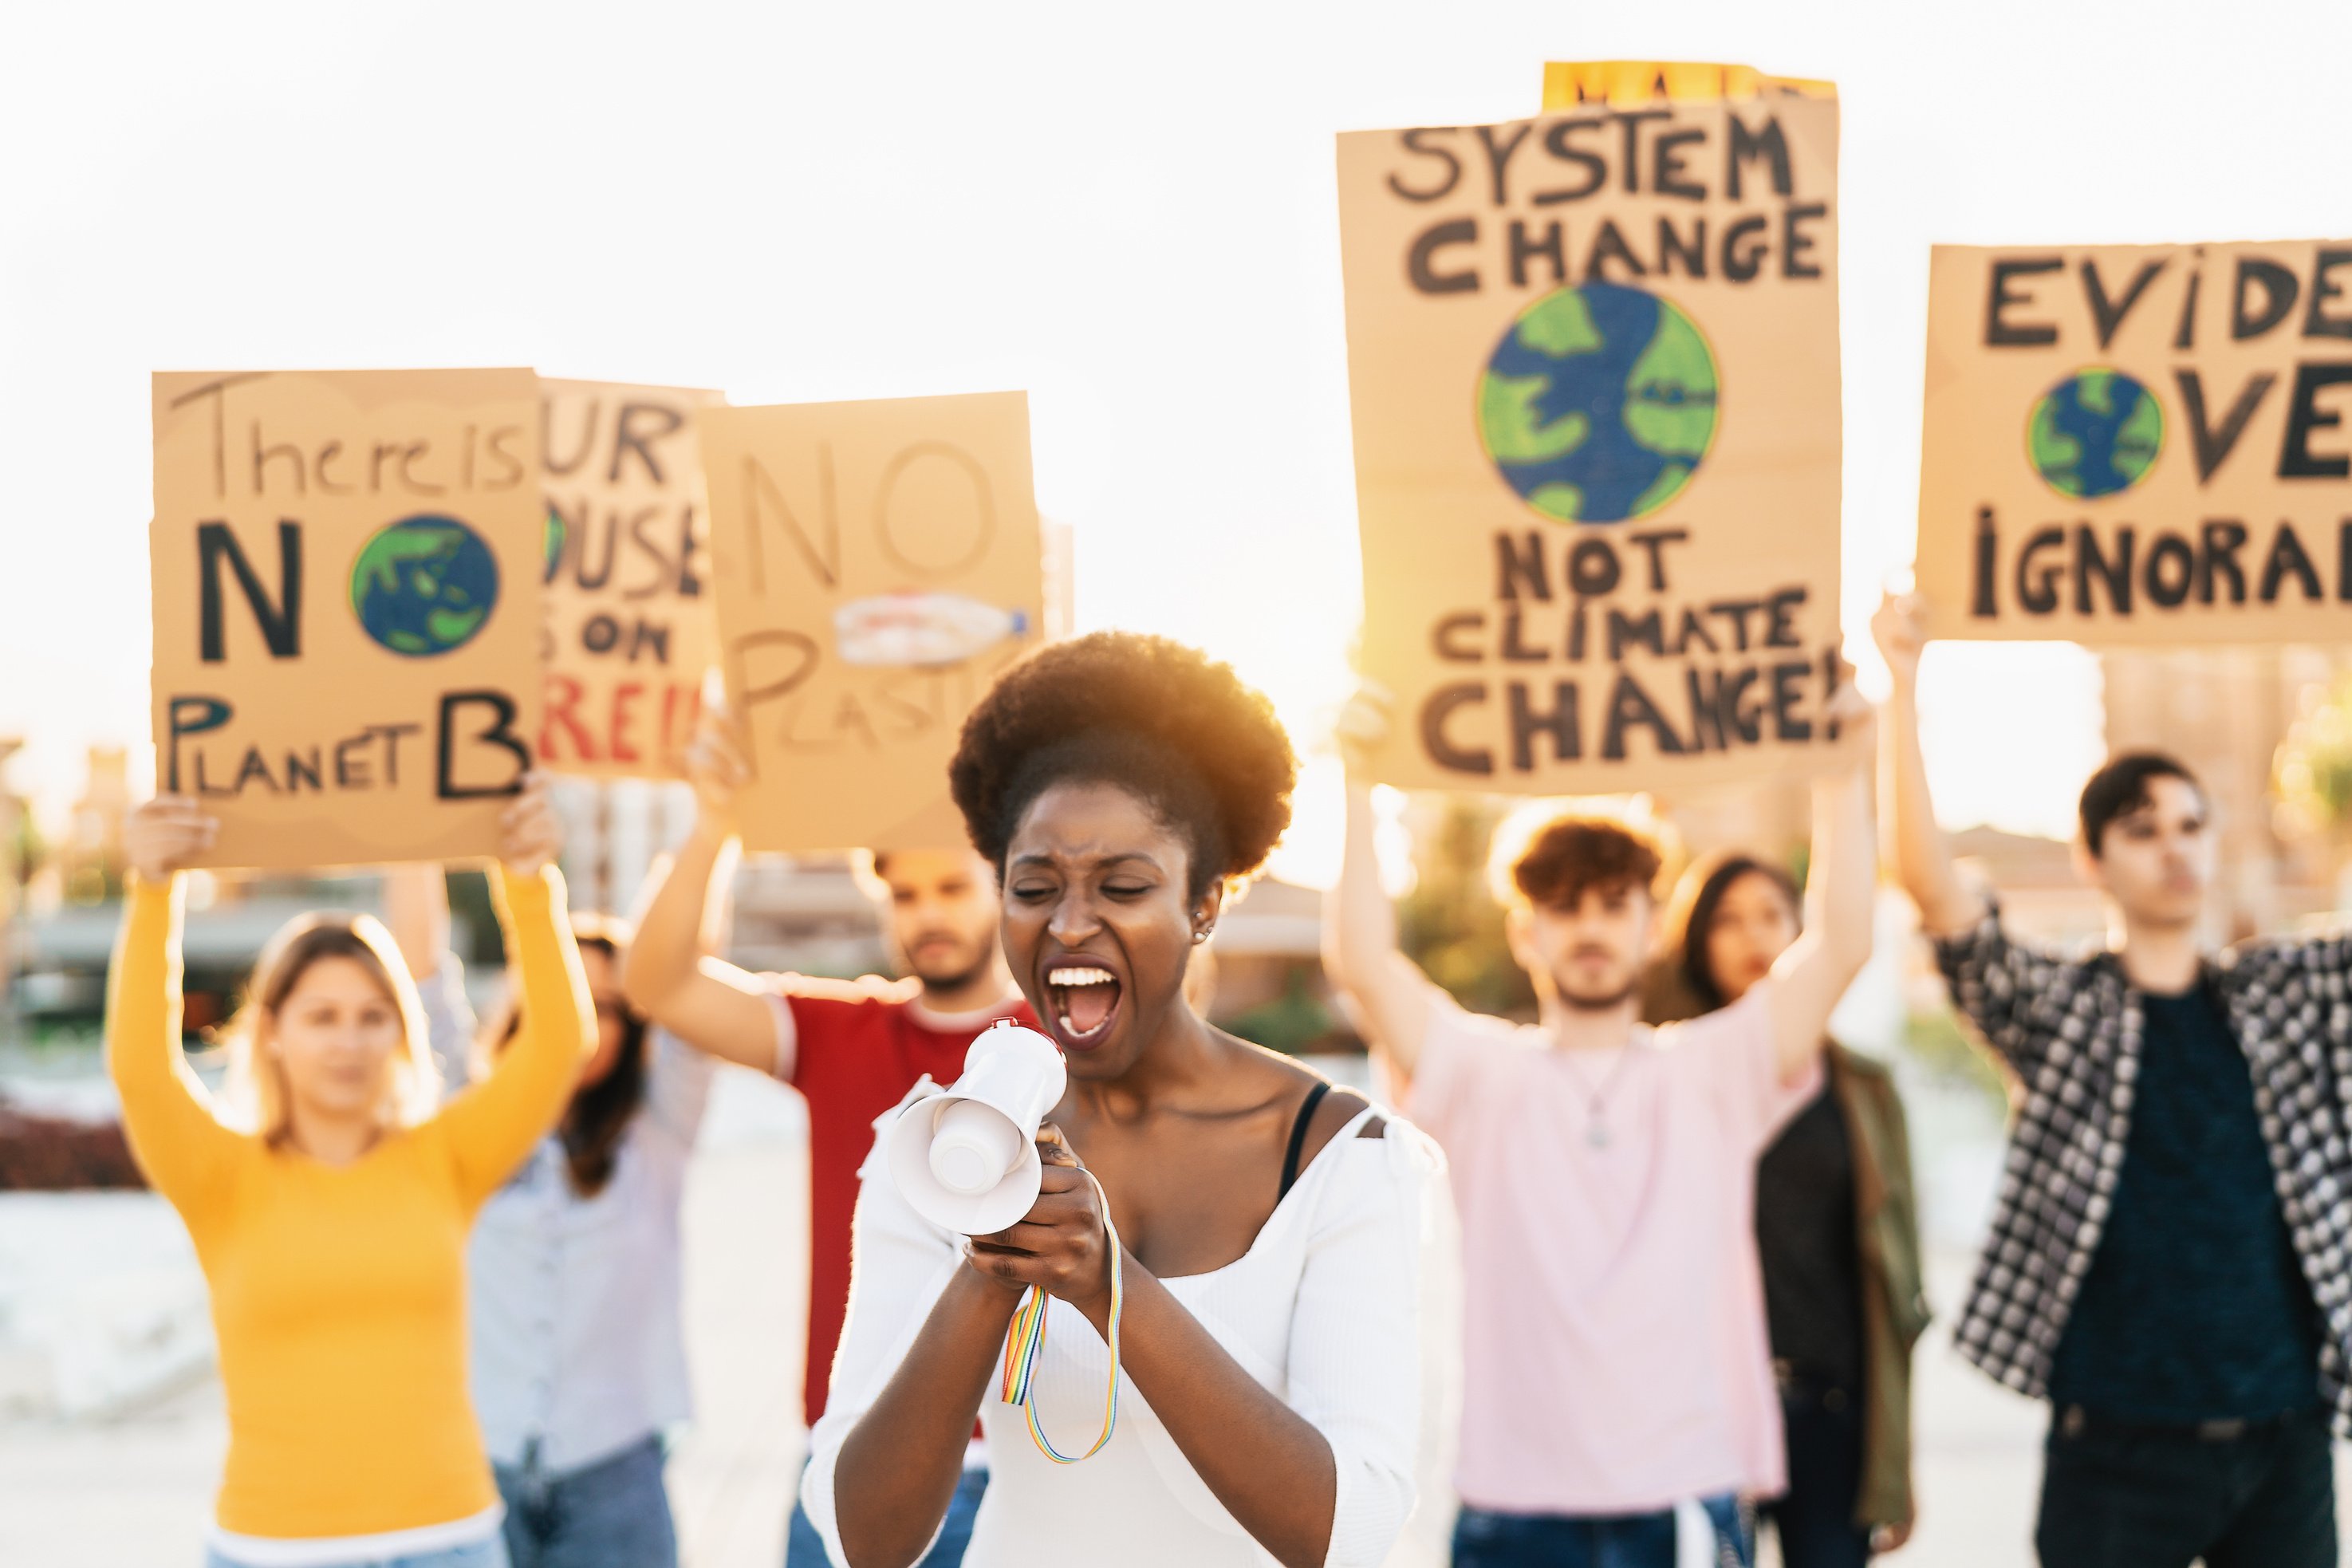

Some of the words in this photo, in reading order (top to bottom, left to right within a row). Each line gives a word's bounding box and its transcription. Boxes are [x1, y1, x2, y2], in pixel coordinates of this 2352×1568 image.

[1385, 108, 1796, 209] SYSTEM
[1405, 202, 1828, 296] CHANGE
[169, 372, 450, 498] There
[538, 394, 687, 483] UR
[739, 438, 1000, 600] NO
[1493, 527, 1689, 601] NOT
[1428, 584, 1809, 663] CLIMATE
[436, 689, 534, 800] B
[1417, 648, 1842, 776] CHANGE!
